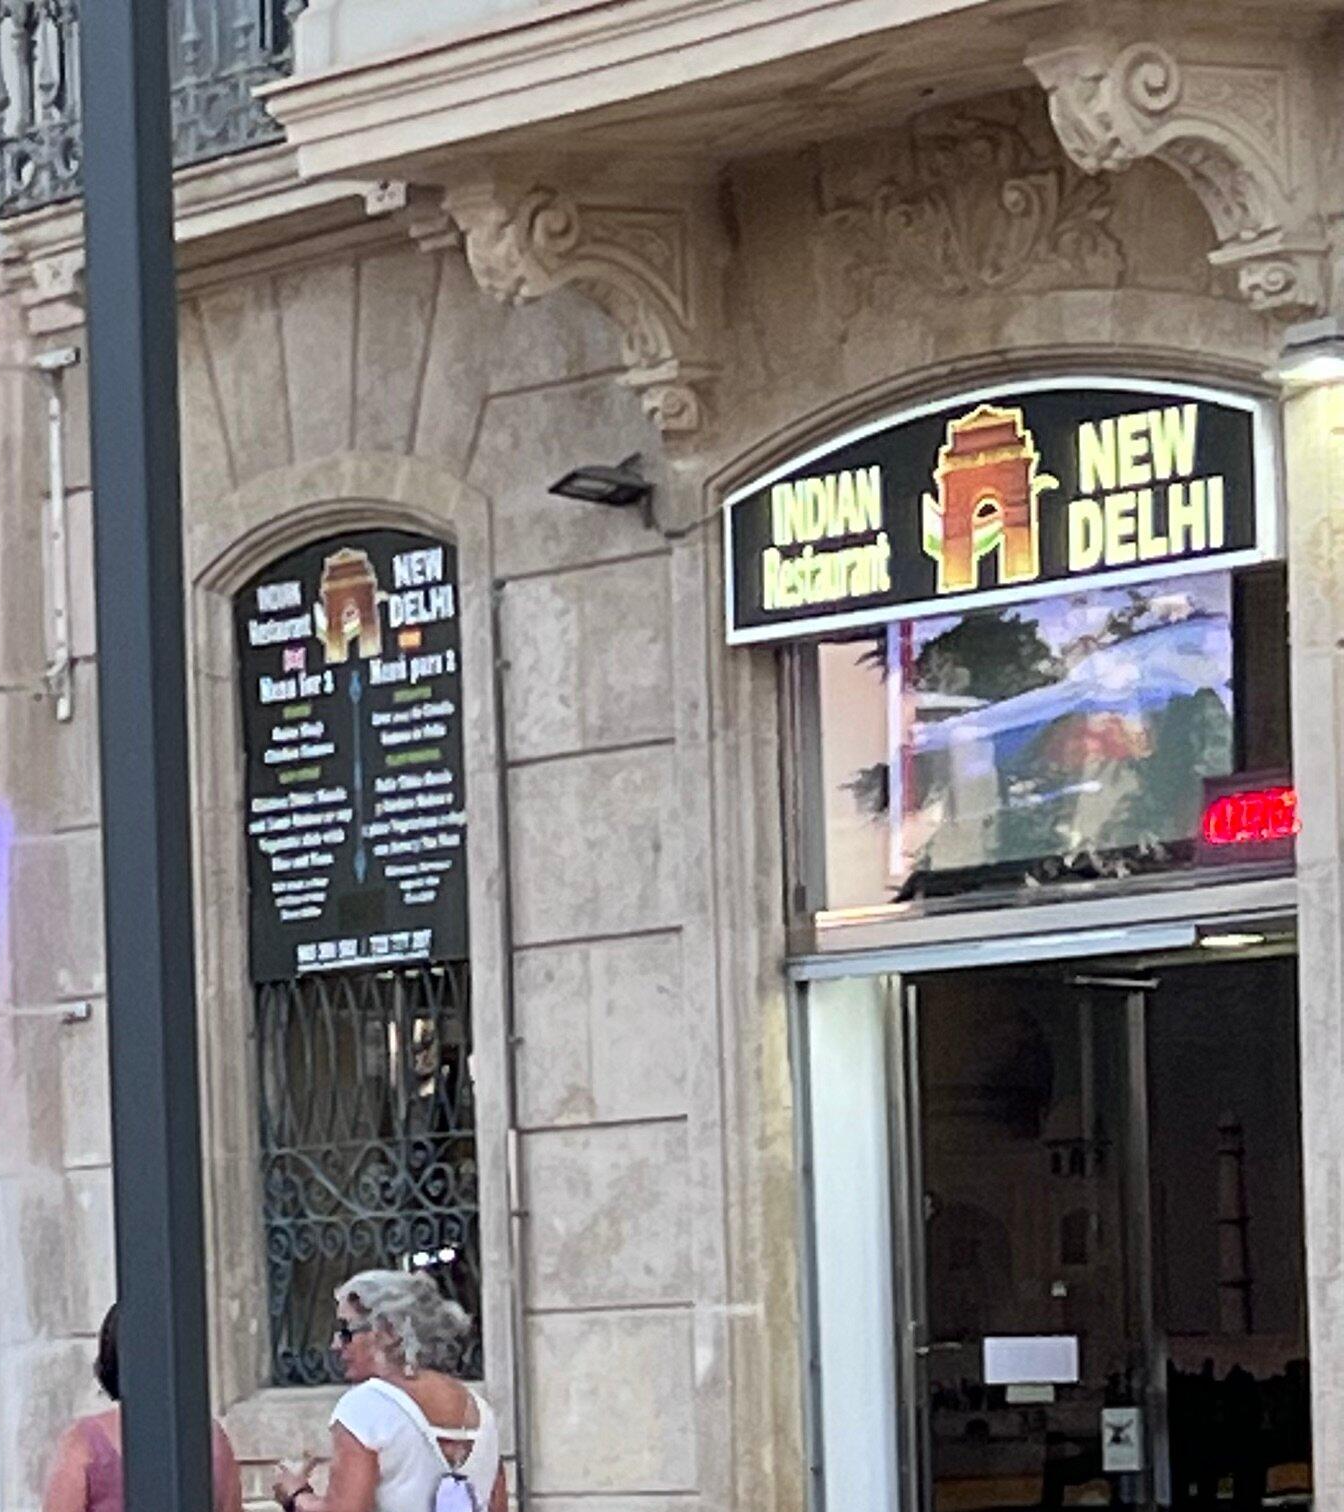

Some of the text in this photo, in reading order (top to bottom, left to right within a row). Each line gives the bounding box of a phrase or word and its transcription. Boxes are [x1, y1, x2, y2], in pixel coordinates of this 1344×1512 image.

[1078, 404, 1199, 494] NEW
[770, 465, 882, 546] INDIAN
[1068, 476, 1224, 571] DELHI
[389, 584, 455, 628] DELHI
[393, 547, 443, 589] NEW
[762, 532, 891, 611] Restaurant
